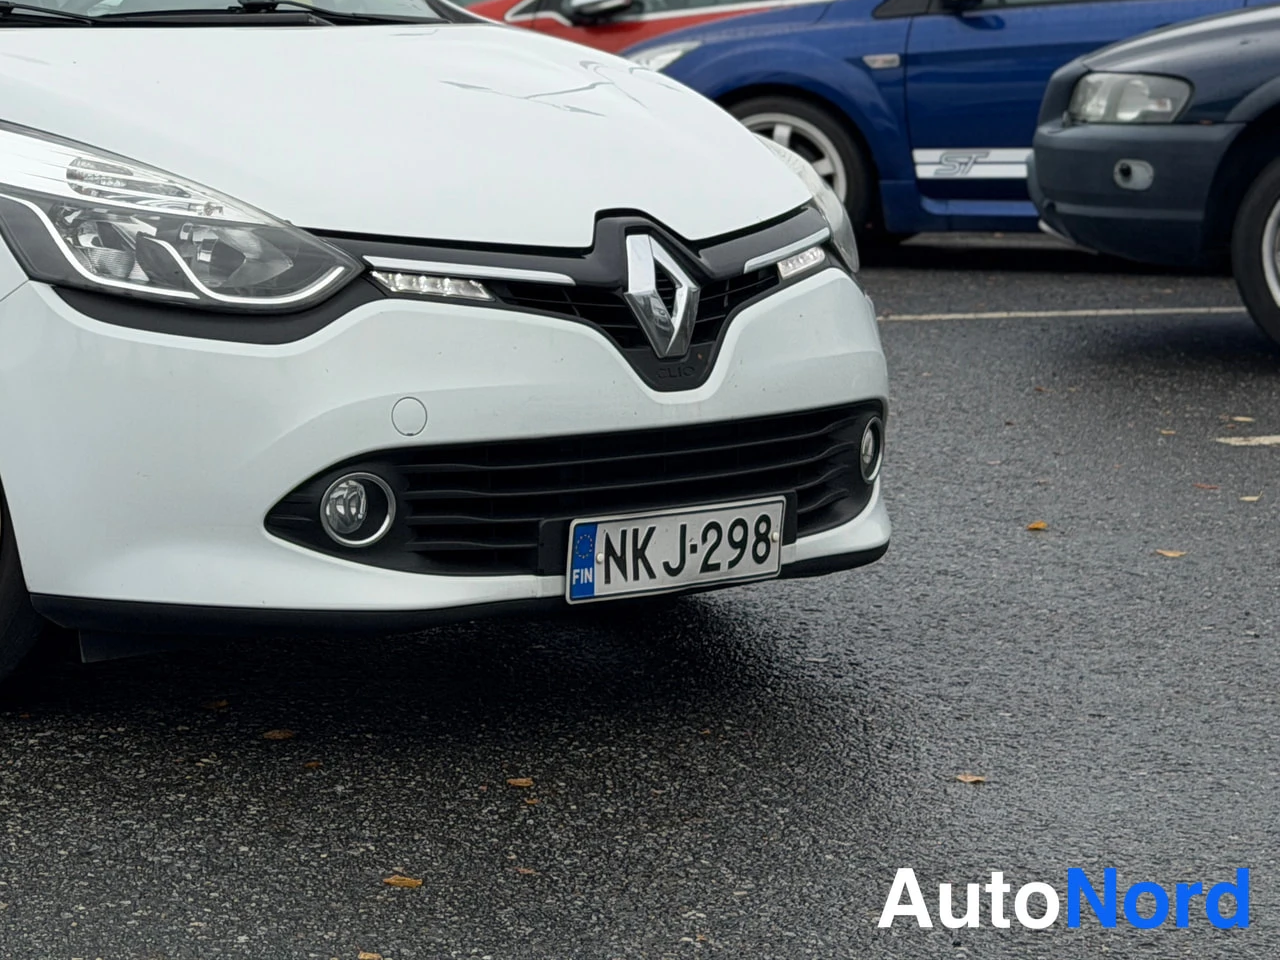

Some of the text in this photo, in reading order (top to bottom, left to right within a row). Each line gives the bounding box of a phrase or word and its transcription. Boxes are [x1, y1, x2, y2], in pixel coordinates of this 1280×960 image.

[933, 150, 991, 176] ST
[657, 366, 696, 378] CLIO
[572, 567, 593, 585] FIN
